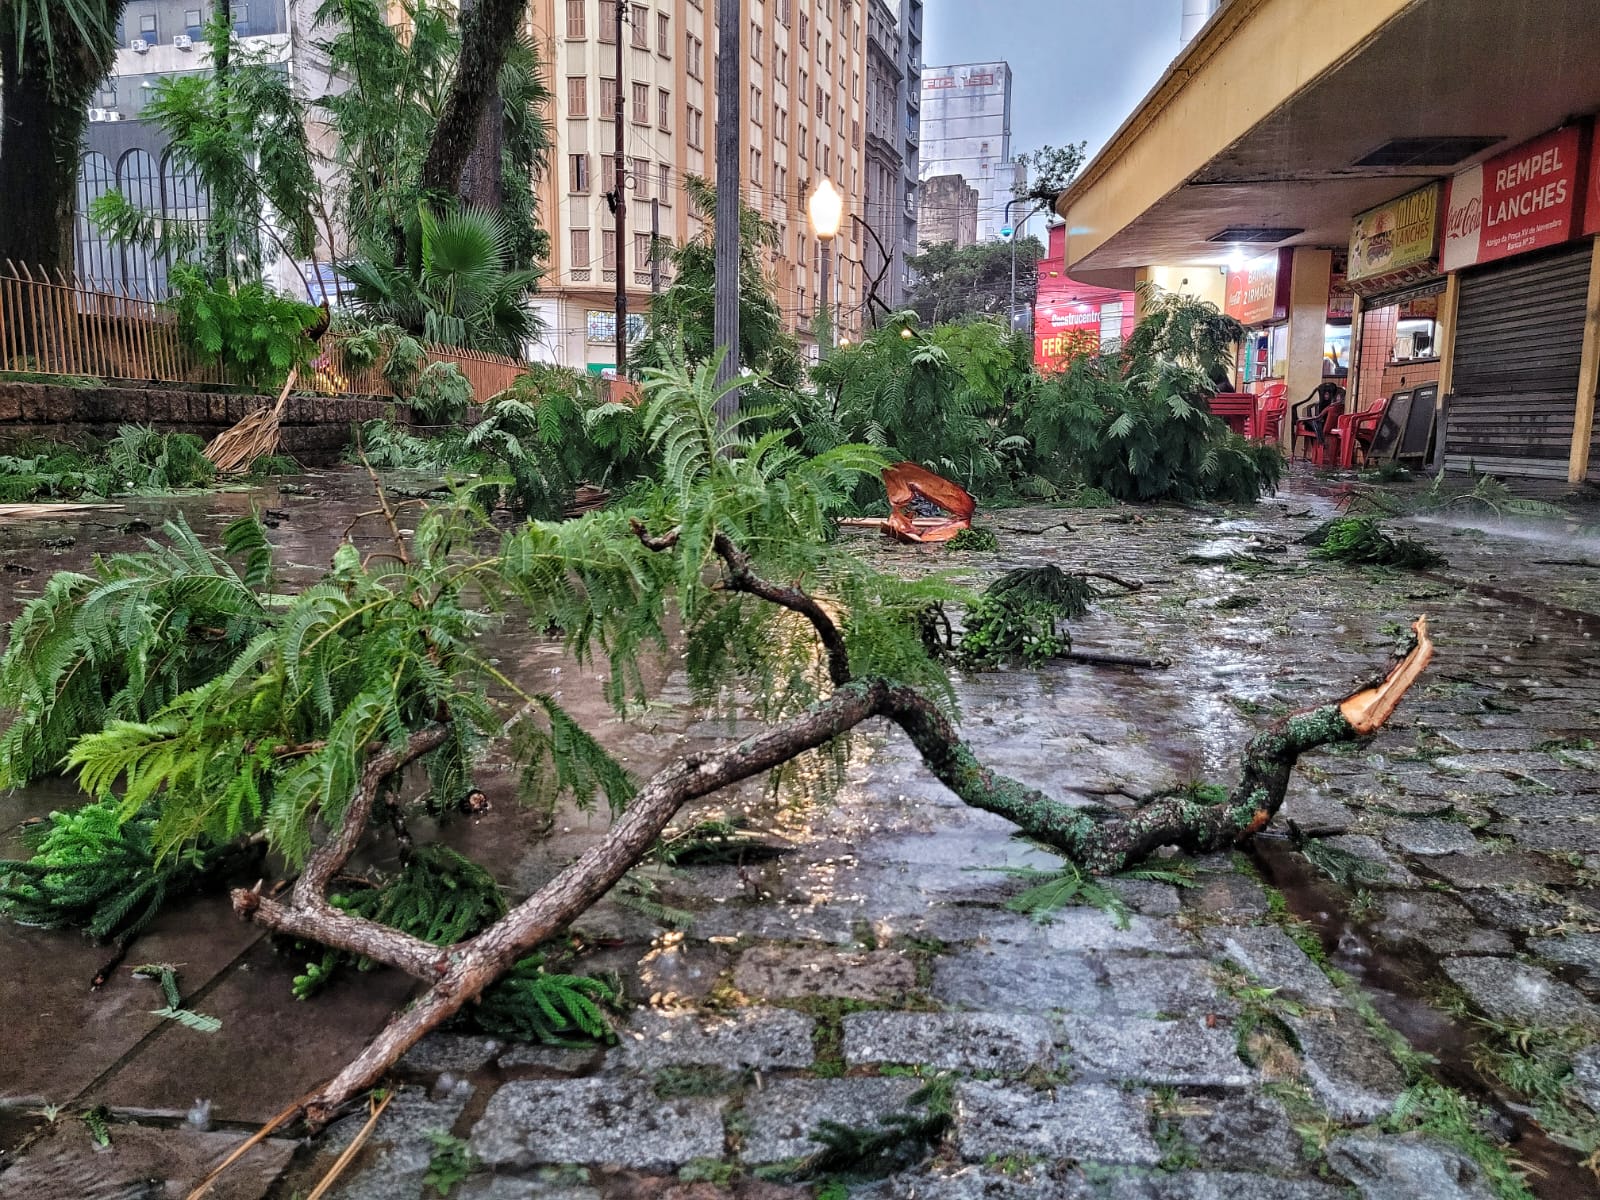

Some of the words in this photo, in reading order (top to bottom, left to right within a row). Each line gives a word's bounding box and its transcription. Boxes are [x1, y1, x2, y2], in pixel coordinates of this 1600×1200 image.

[1496, 147, 1563, 192] REMPEL
[1487, 179, 1567, 227] LANCHES
[1396, 222, 1429, 247] LANCHES
